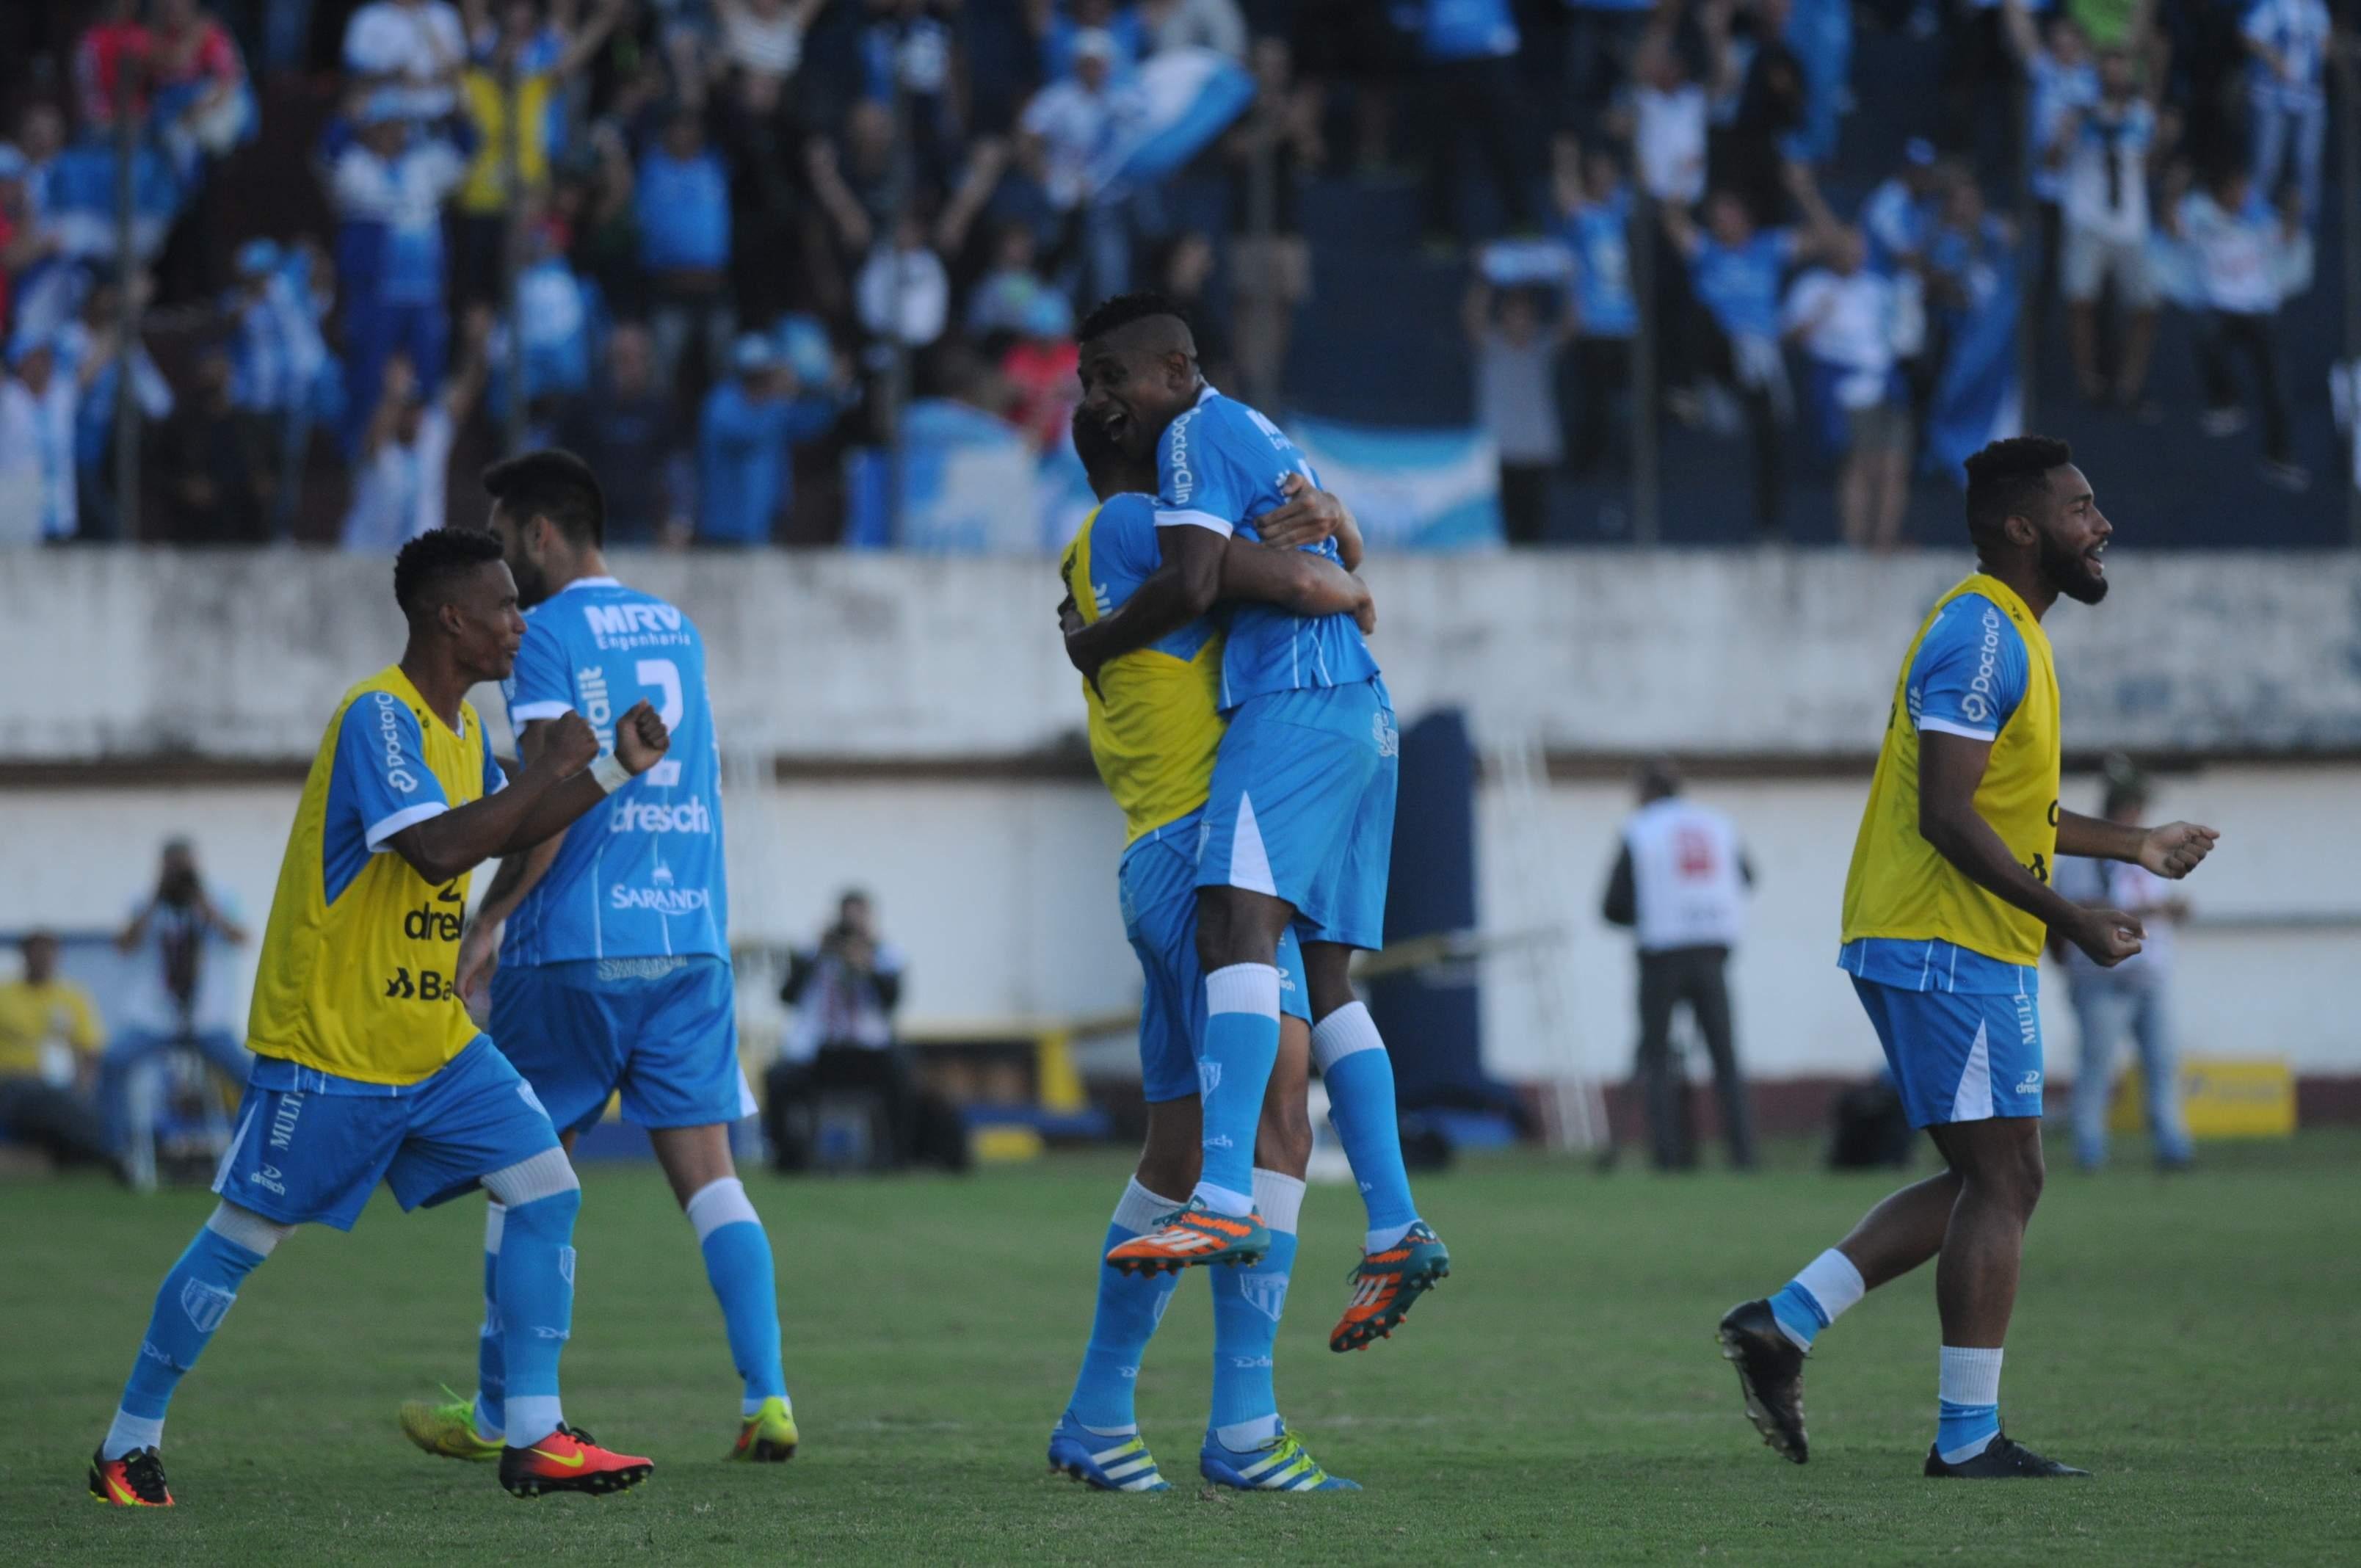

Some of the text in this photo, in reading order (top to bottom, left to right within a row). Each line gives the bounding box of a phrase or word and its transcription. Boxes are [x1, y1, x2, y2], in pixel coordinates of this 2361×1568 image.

[1172, 412, 1193, 504] DoctorClin
[584, 603, 682, 634] MRV
[596, 631, 692, 650] Engenharia
[578, 666, 614, 759] aralit
[610, 794, 711, 834] dresch
[612, 883, 710, 912] SARANDI
[269, 1088, 305, 1151] MULT
